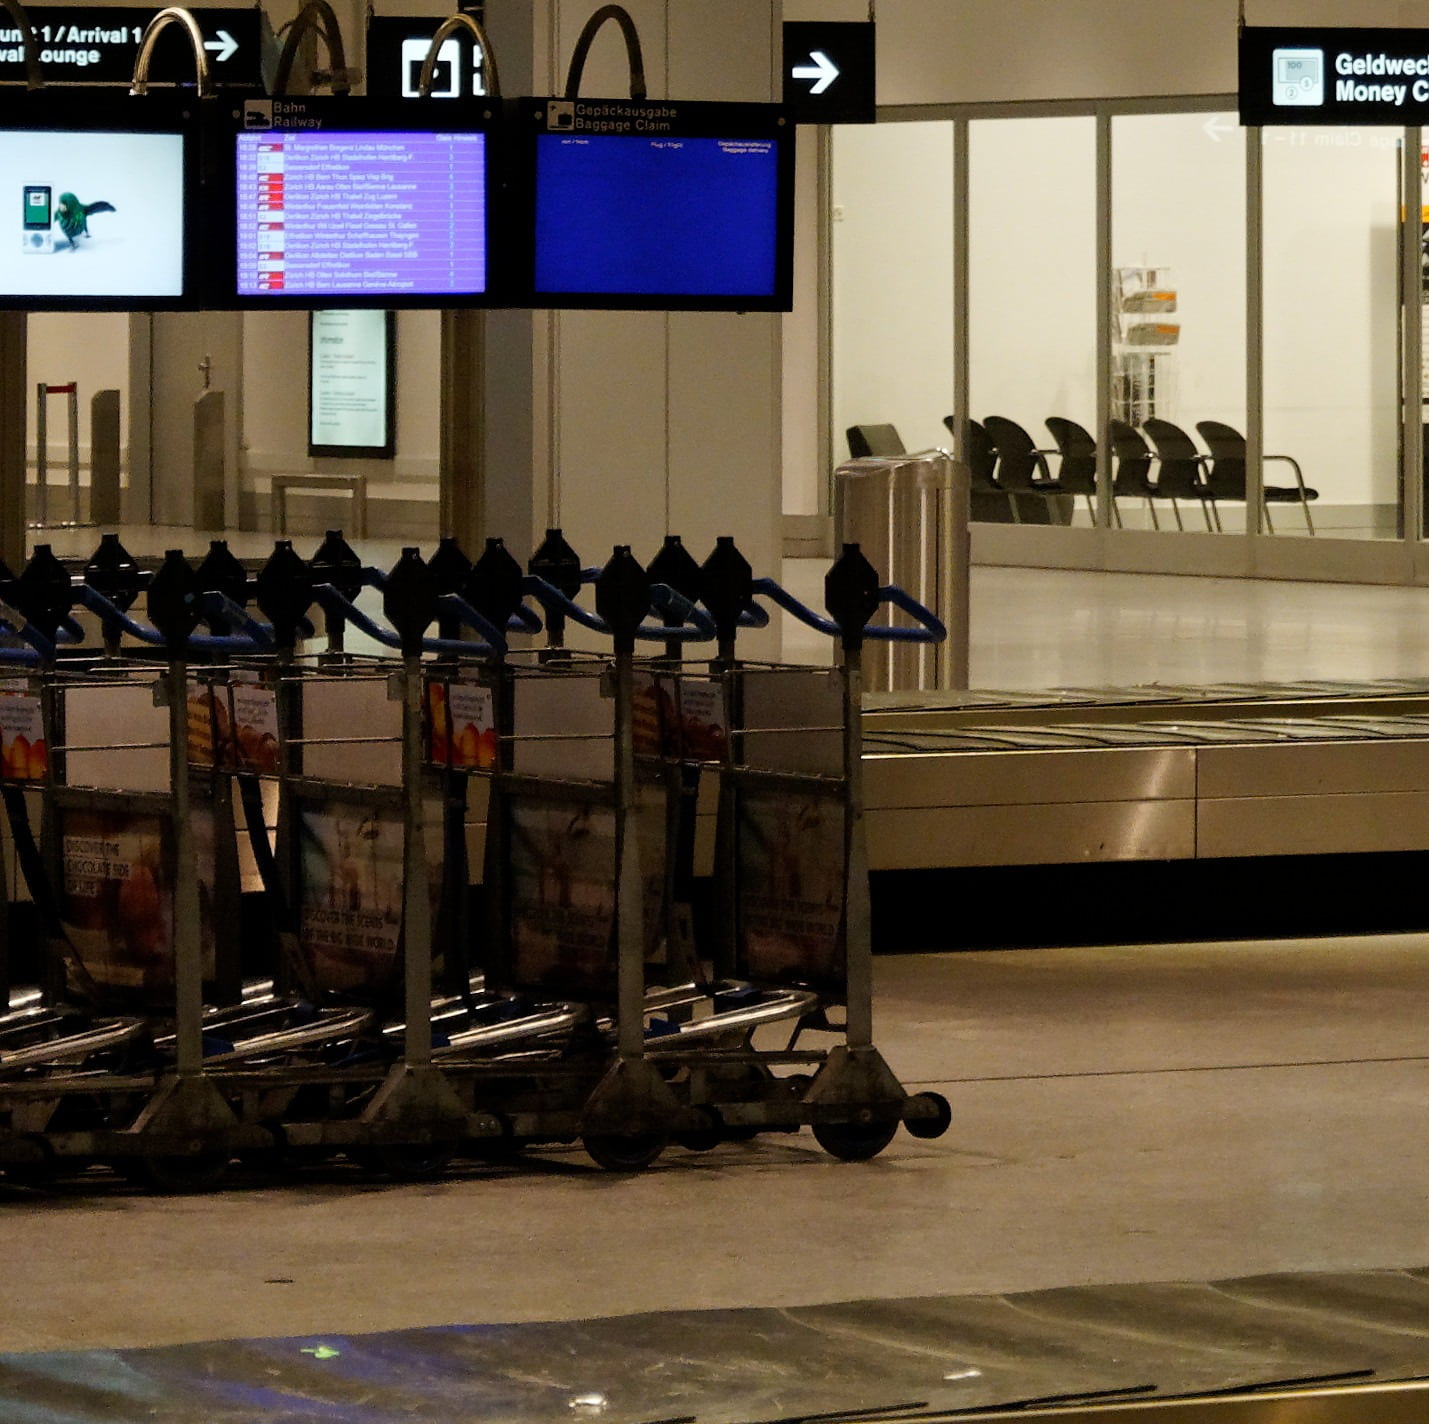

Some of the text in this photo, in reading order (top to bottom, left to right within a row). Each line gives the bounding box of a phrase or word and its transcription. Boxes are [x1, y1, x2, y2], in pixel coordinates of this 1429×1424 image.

[67, 26, 127, 43] Arrival
[38, 50, 101, 66] ounge
[1336, 80, 1406, 106] Money
[273, 102, 306, 113] Bahn
[576, 103, 677, 118] Gepäckausgabe
[273, 116, 322, 130] Railway
[576, 119, 670, 131] Baggage Claim
